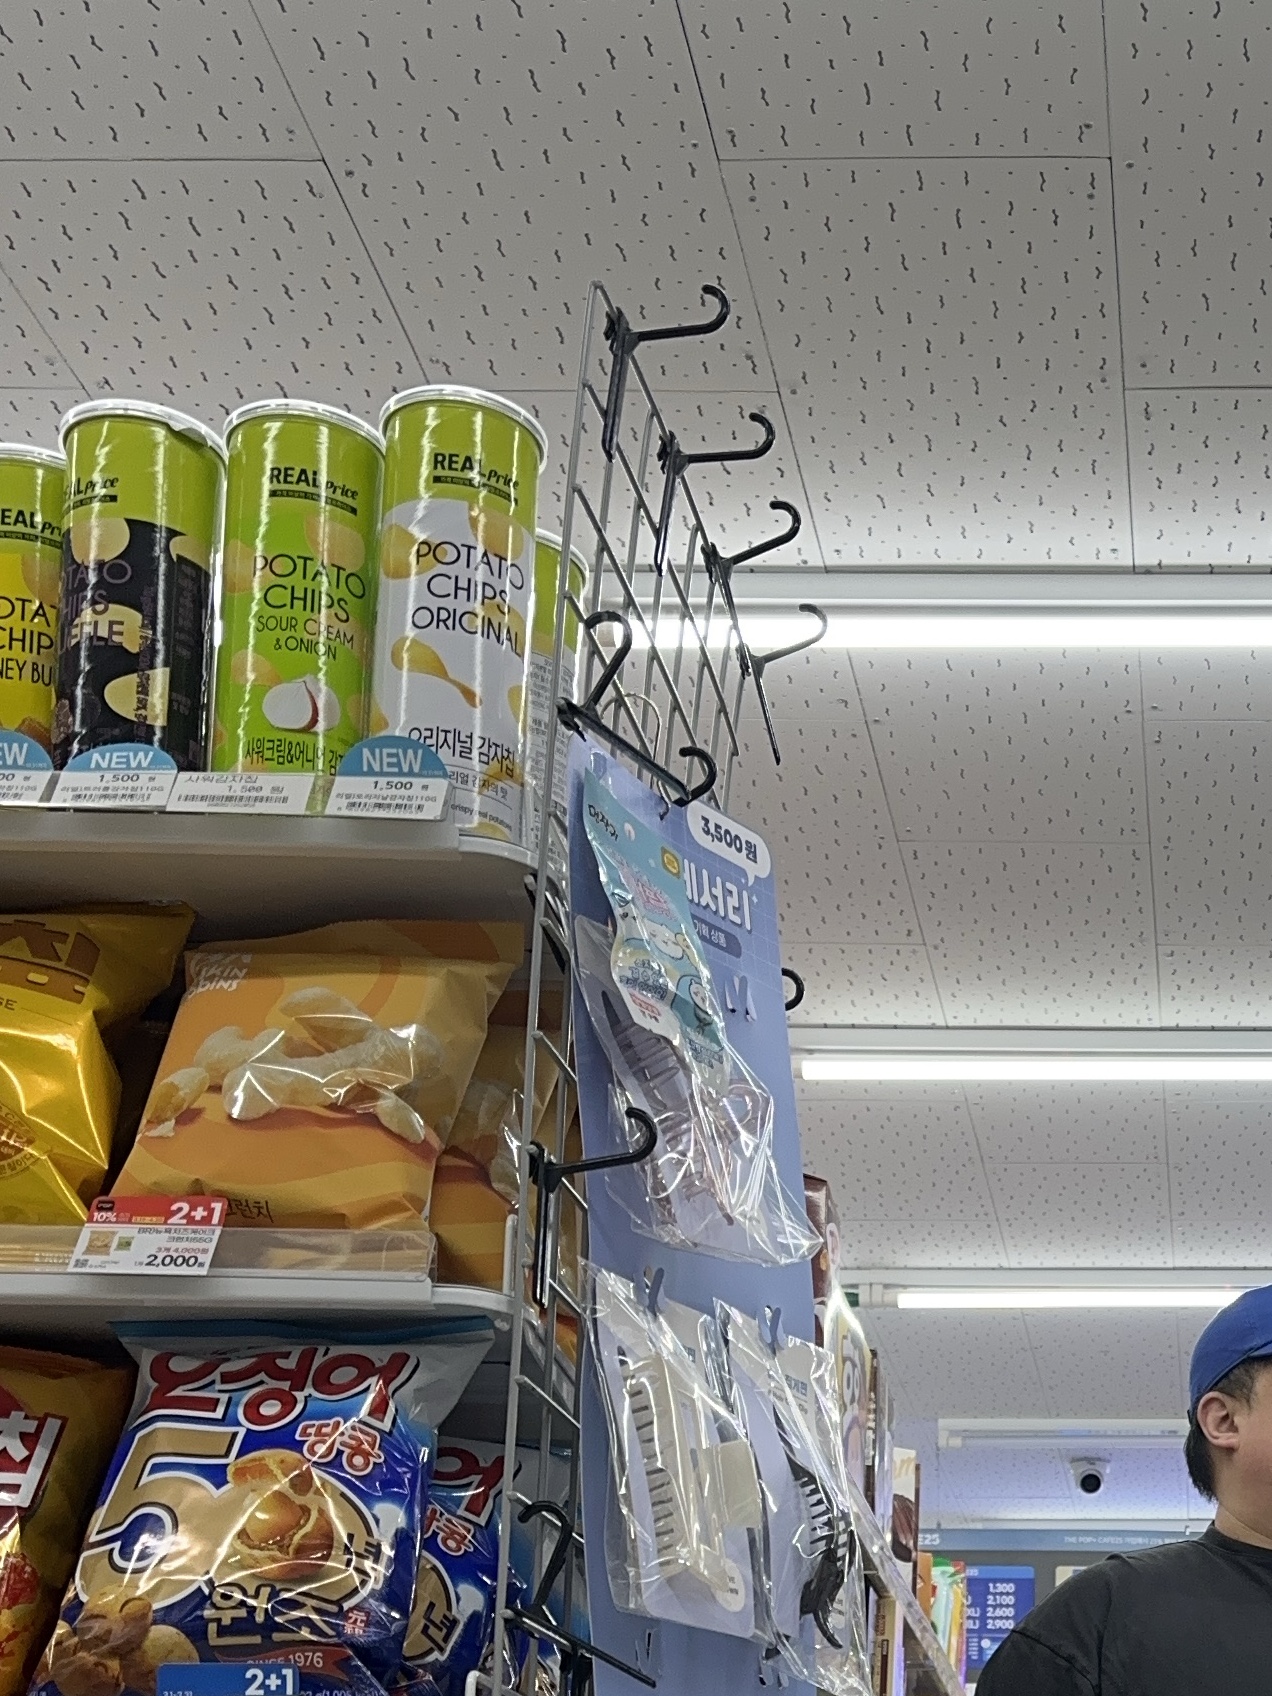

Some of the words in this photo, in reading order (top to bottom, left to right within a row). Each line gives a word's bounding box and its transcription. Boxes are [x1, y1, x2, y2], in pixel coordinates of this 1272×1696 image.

[0, 508, 42, 529] EAL
[253, 554, 366, 599] POTATO
[416, 542, 524, 590] POTATO
[263, 584, 350, 623] CHIPS
[427, 573, 512, 616] CHIPS
[256, 615, 298, 633] SOUR
[304, 617, 354, 650] CREAM
[411, 606, 523, 657] ORIGINAL
[90, 751, 154, 770] NEW
[362, 747, 424, 774] NEW
[373, 780, 413, 791] 1,500
[166, 1201, 223, 1225] 2+1
[137, 1346, 420, 1432] 오징어
[296, 1416, 384, 1476] 땅콩
[204, 1582, 347, 1647] 원조
[288, 1652, 324, 1669] 1976
[244, 1667, 295, 1696] 2+1
